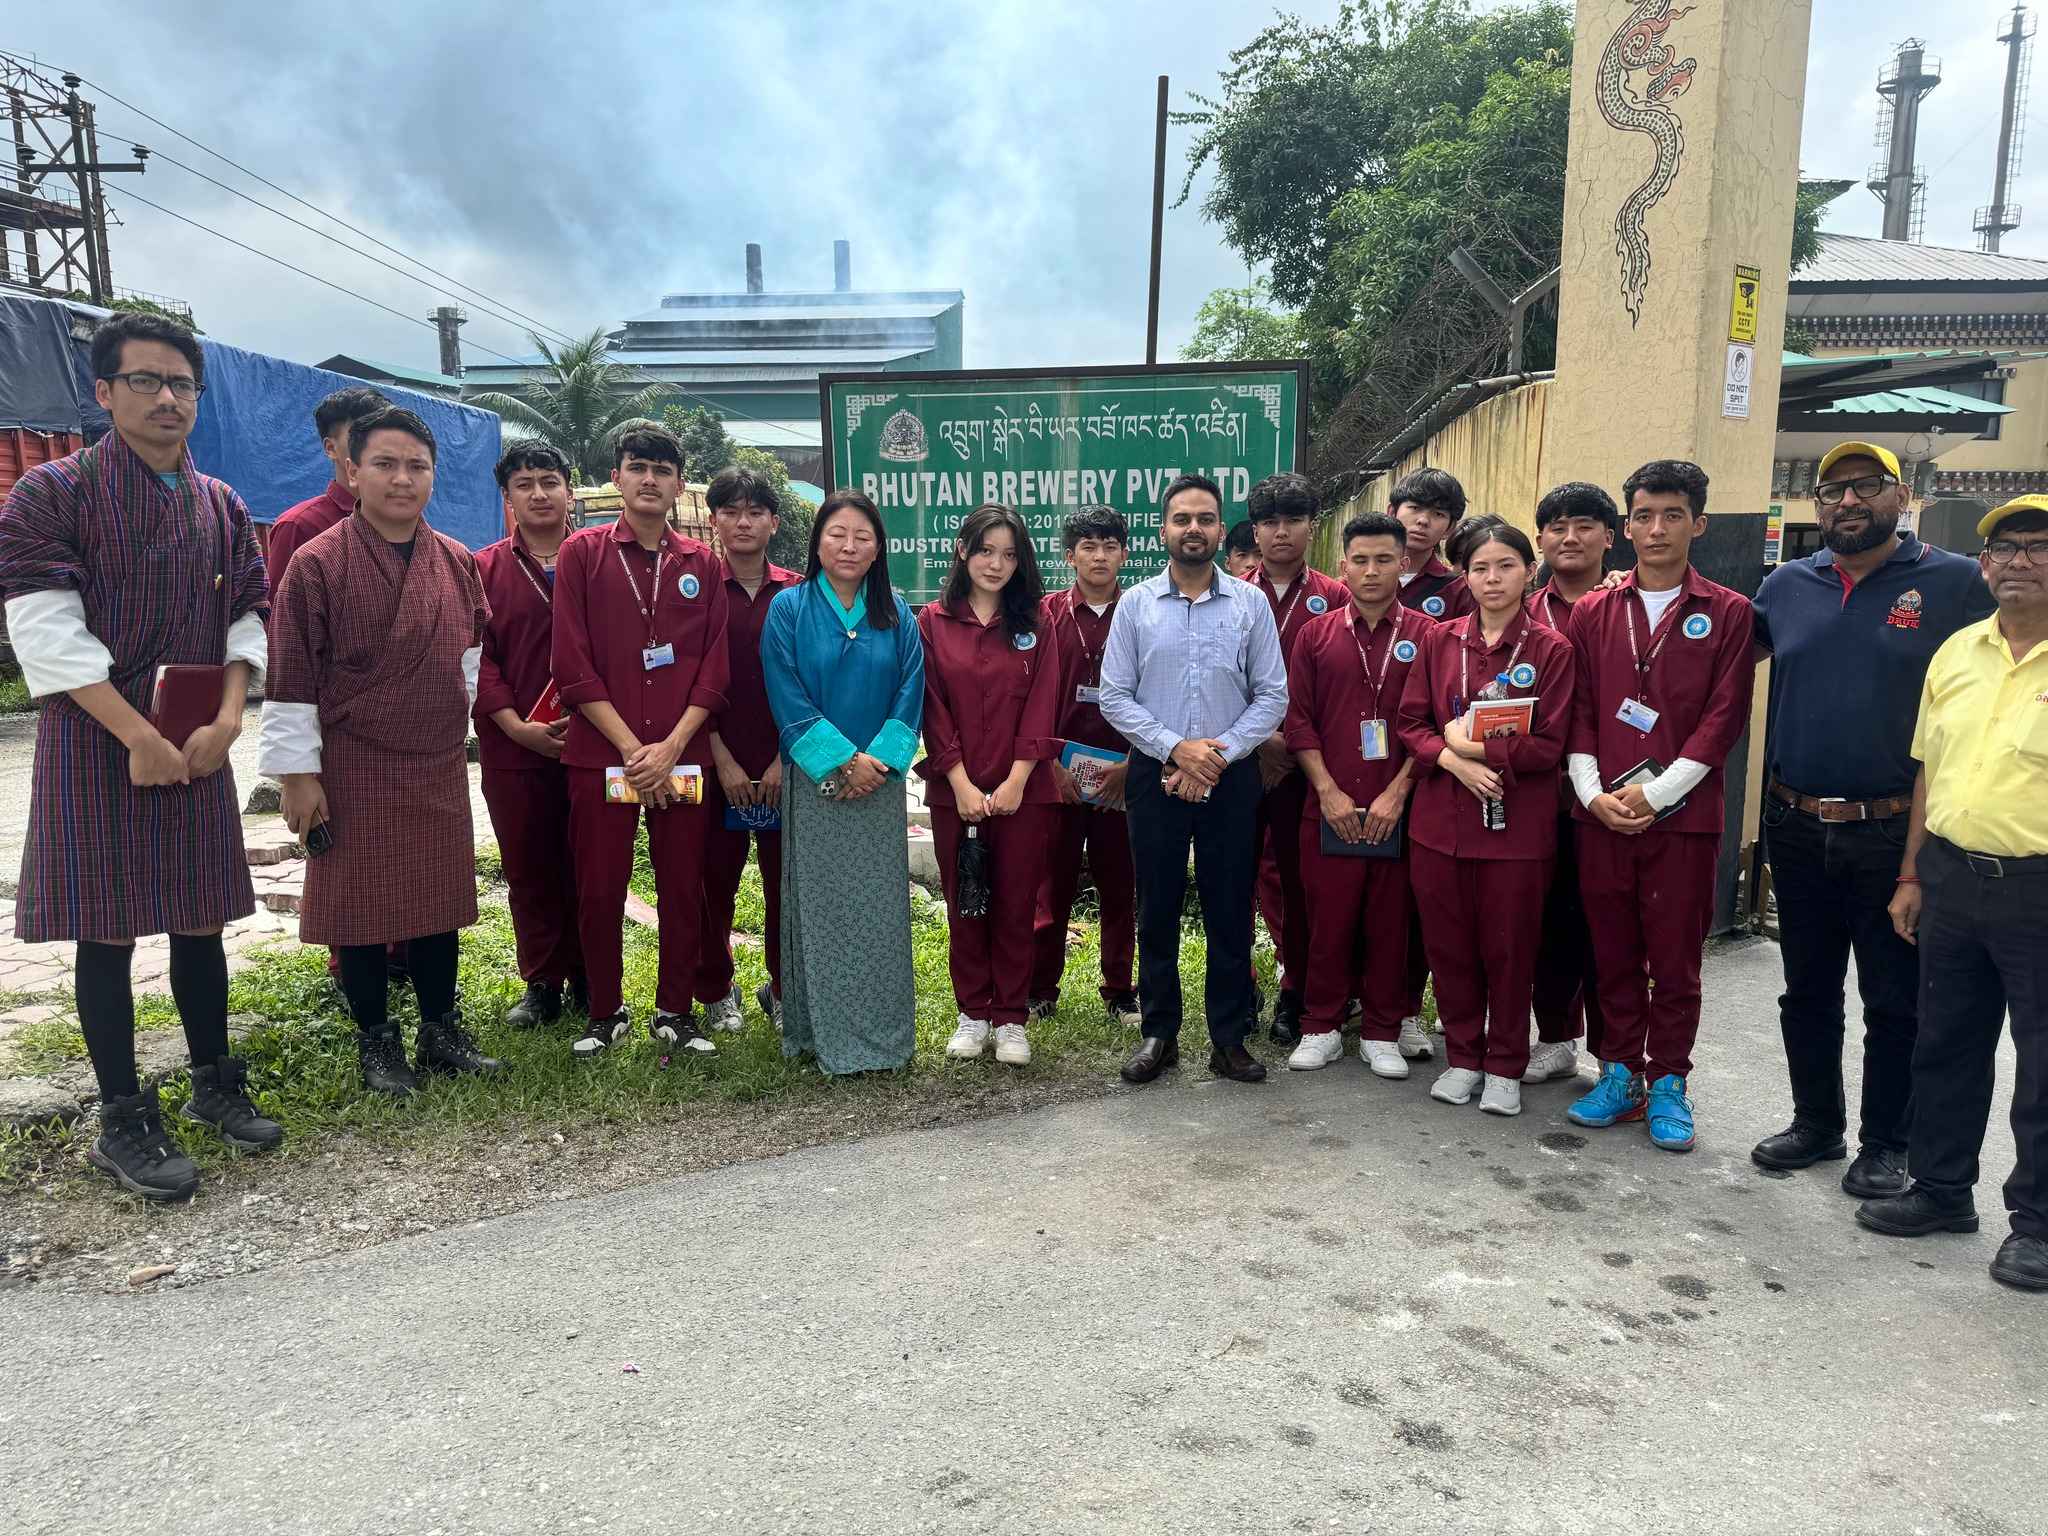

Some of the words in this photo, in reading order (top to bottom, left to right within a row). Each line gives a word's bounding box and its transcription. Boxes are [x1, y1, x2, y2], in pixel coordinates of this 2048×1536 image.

[863, 471, 973, 507] BHUTAN
[983, 469, 1118, 506] BREWERY
[1198, 466, 1250, 503] TD
[885, 537, 957, 553] DUSTR
